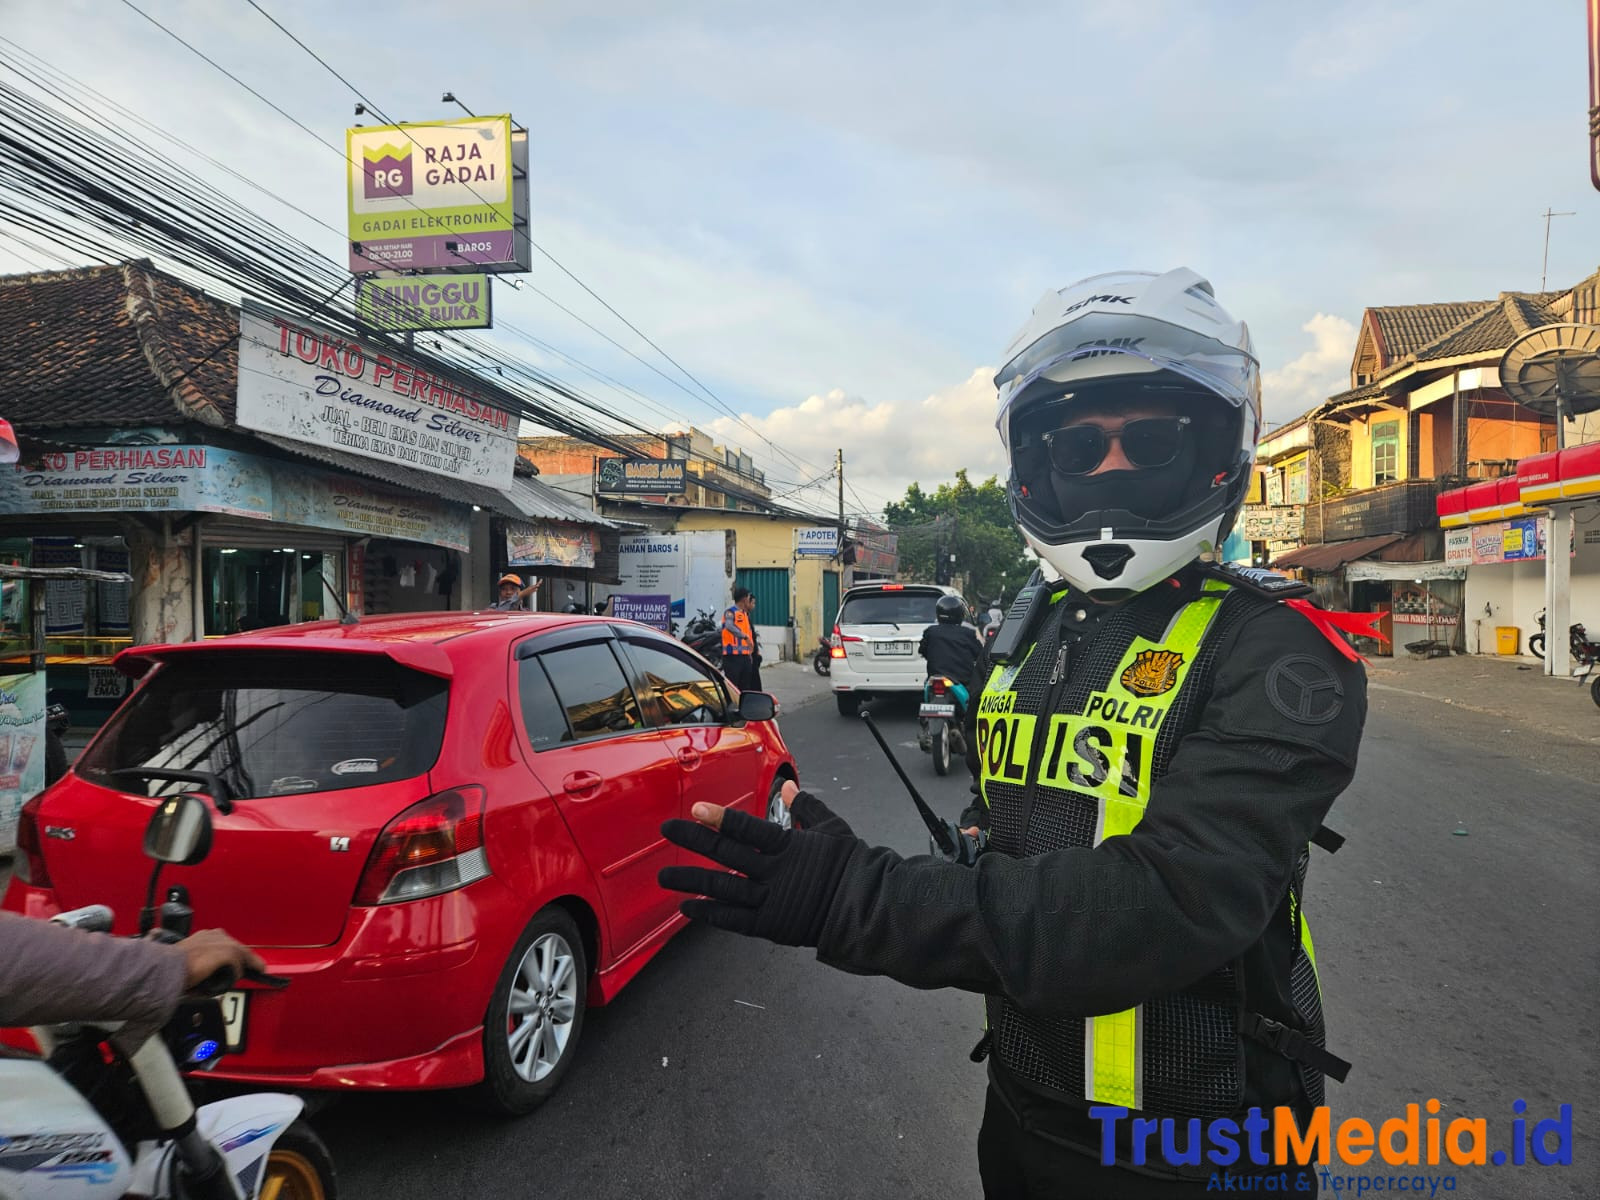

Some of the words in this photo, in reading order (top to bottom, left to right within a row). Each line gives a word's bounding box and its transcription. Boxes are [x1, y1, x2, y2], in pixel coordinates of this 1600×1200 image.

[425, 143, 482, 164] RAJA
[374, 169, 403, 189] RG
[425, 164, 495, 186] GADAI
[363, 219, 406, 233] GADAI
[411, 212, 498, 230] ELEKTRONIK
[457, 241, 492, 253] BAROS
[372, 281, 480, 307] MINGGU
[429, 304, 480, 321] BUKA
[1062, 294, 1136, 317] SMK
[1072, 337, 1147, 362] SMK
[273, 316, 365, 380] TOKO
[373, 354, 509, 432] PERHIASAN
[314, 375, 422, 424] Diamond
[426, 413, 481, 444] Silver
[321, 406, 351, 427] JUAL
[361, 416, 387, 437] BELI
[389, 424, 418, 446] EMAS
[419, 433, 441, 452] DAN
[333, 428, 370, 450] TERIMA
[371, 438, 396, 457] EMAS
[399, 446, 418, 463] DARI
[419, 451, 443, 469] TOKO
[74, 448, 206, 471] PERHIASAN
[23, 473, 118, 487] Diamond
[124, 472, 190, 485] Silver
[625, 462, 659, 479] BAROS
[660, 463, 684, 480] JAM
[333, 495, 394, 515] Diamond
[805, 531, 837, 540] APOTEK
[647, 544, 672, 553] BAROS
[673, 544, 679, 552] 4
[1447, 548, 1472, 560] GRATIS
[614, 603, 642, 611] BUTUH
[643, 604, 667, 612] UANG
[614, 612, 633, 620] ABIS
[634, 612, 667, 620] MUDIK?
[94, 687, 121, 696] EMAS
[96, 678, 117, 687] JUAL
[980, 695, 1013, 714] ANGGA
[1086, 696, 1165, 730] POLRI
